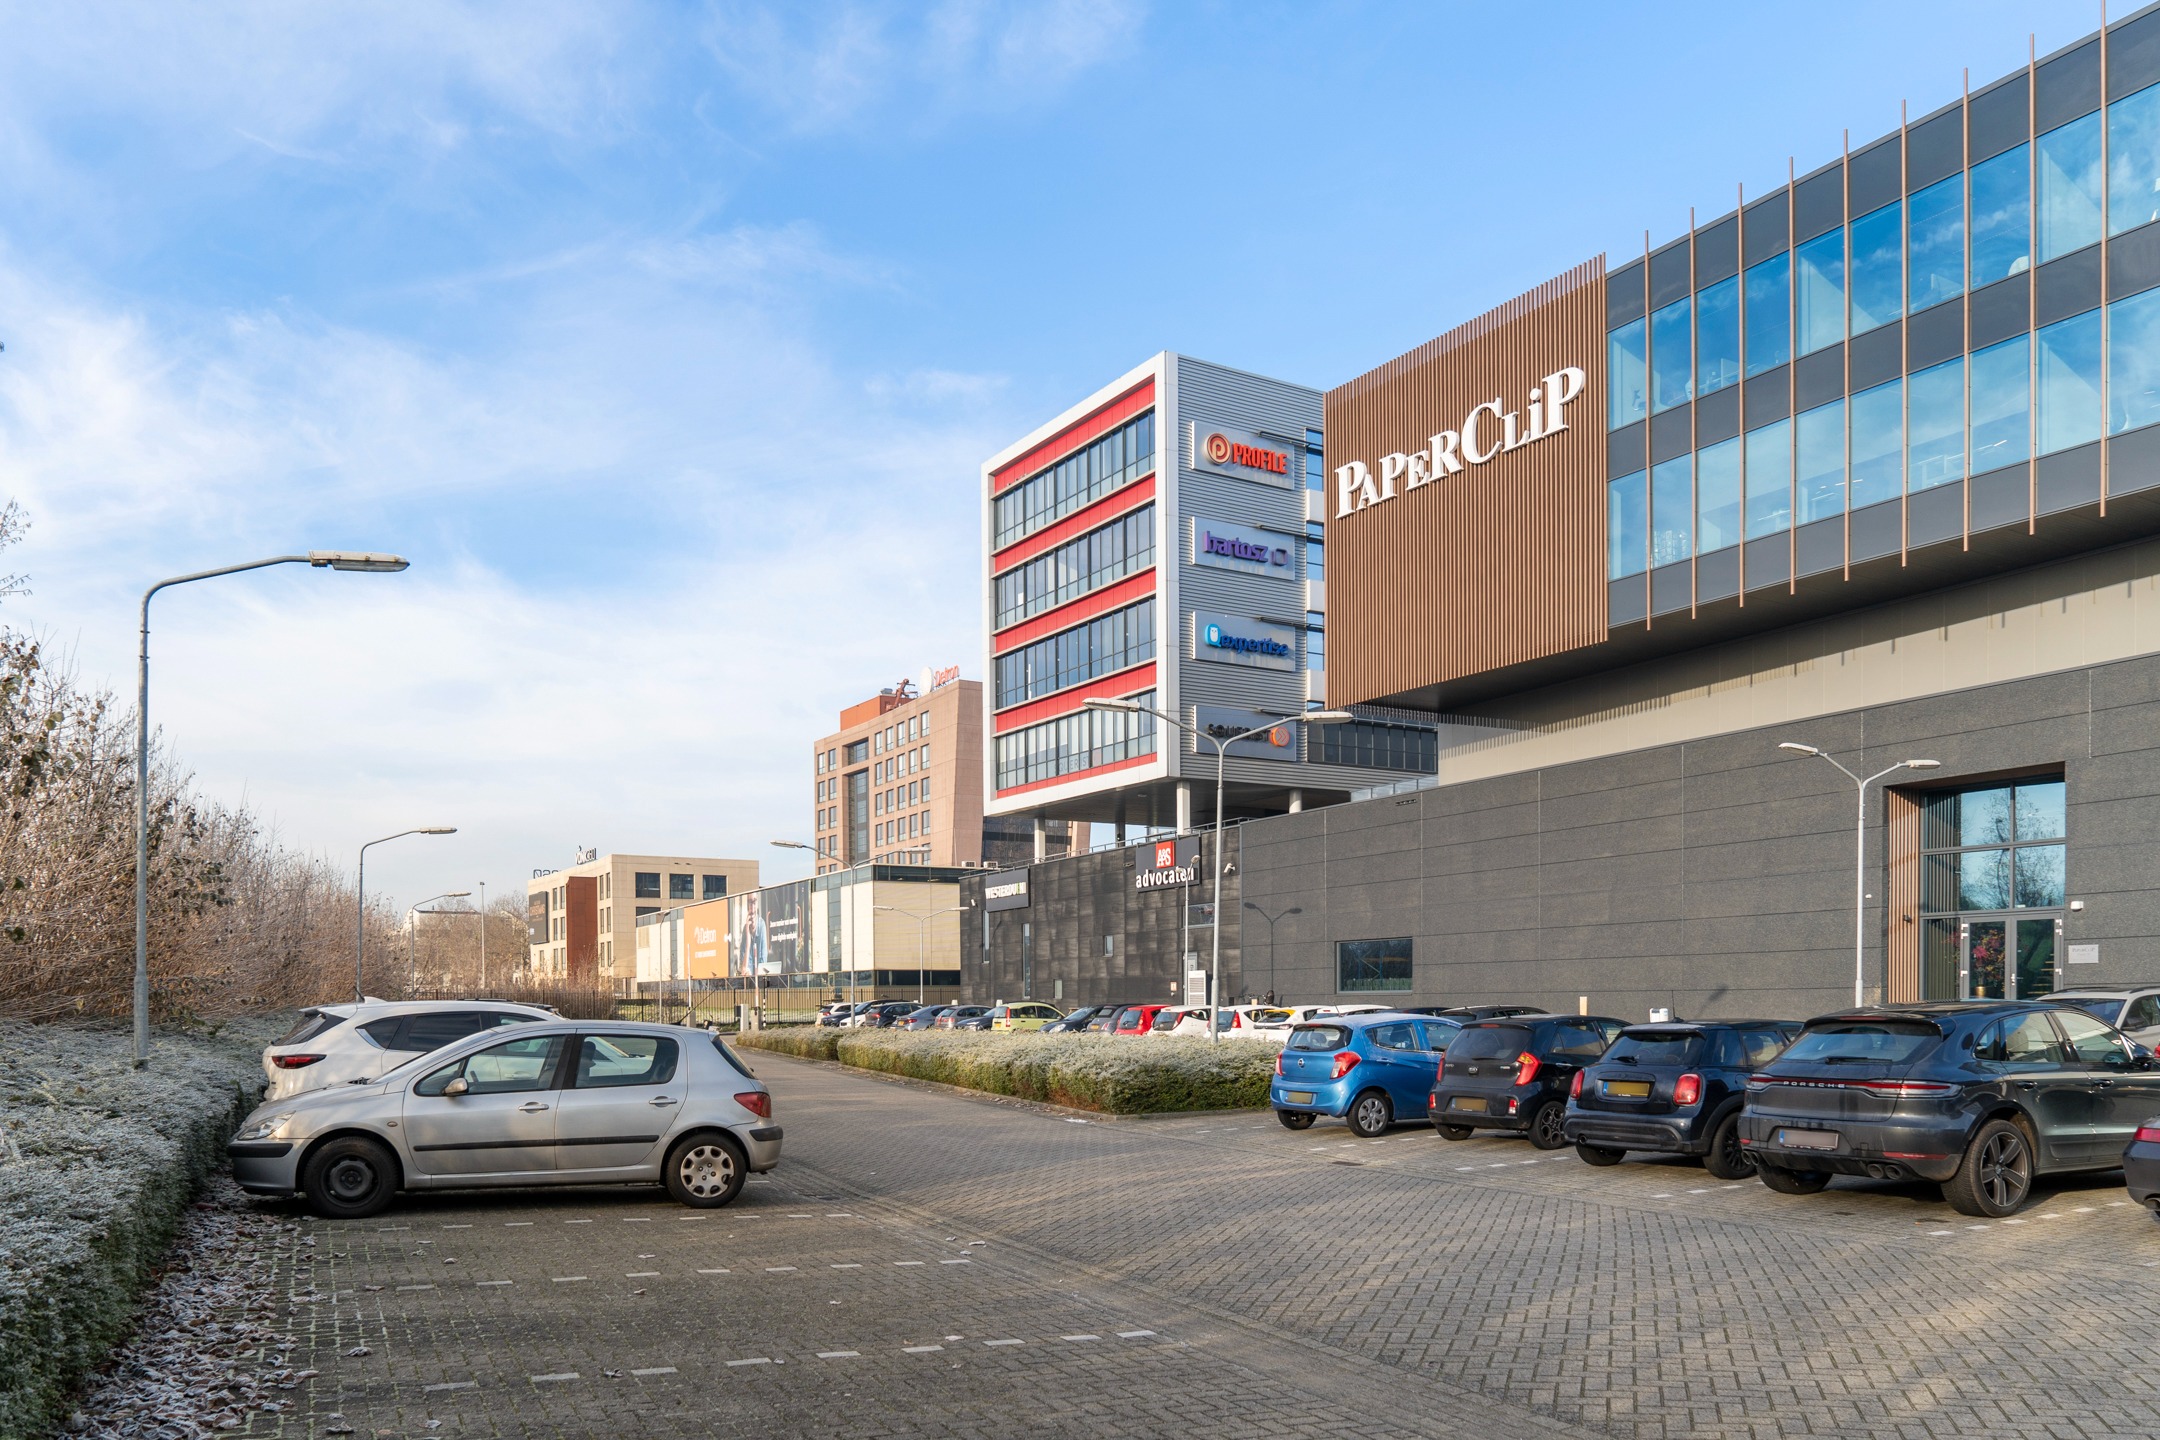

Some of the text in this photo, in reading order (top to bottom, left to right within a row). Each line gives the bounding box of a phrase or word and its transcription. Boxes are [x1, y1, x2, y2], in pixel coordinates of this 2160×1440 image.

[1232, 442, 1288, 474] PROFILE
[1203, 531, 1269, 563] bartosz
[1135, 867, 1195, 889] advocaten
[1783, 1081, 1845, 1089] PORSCHE
